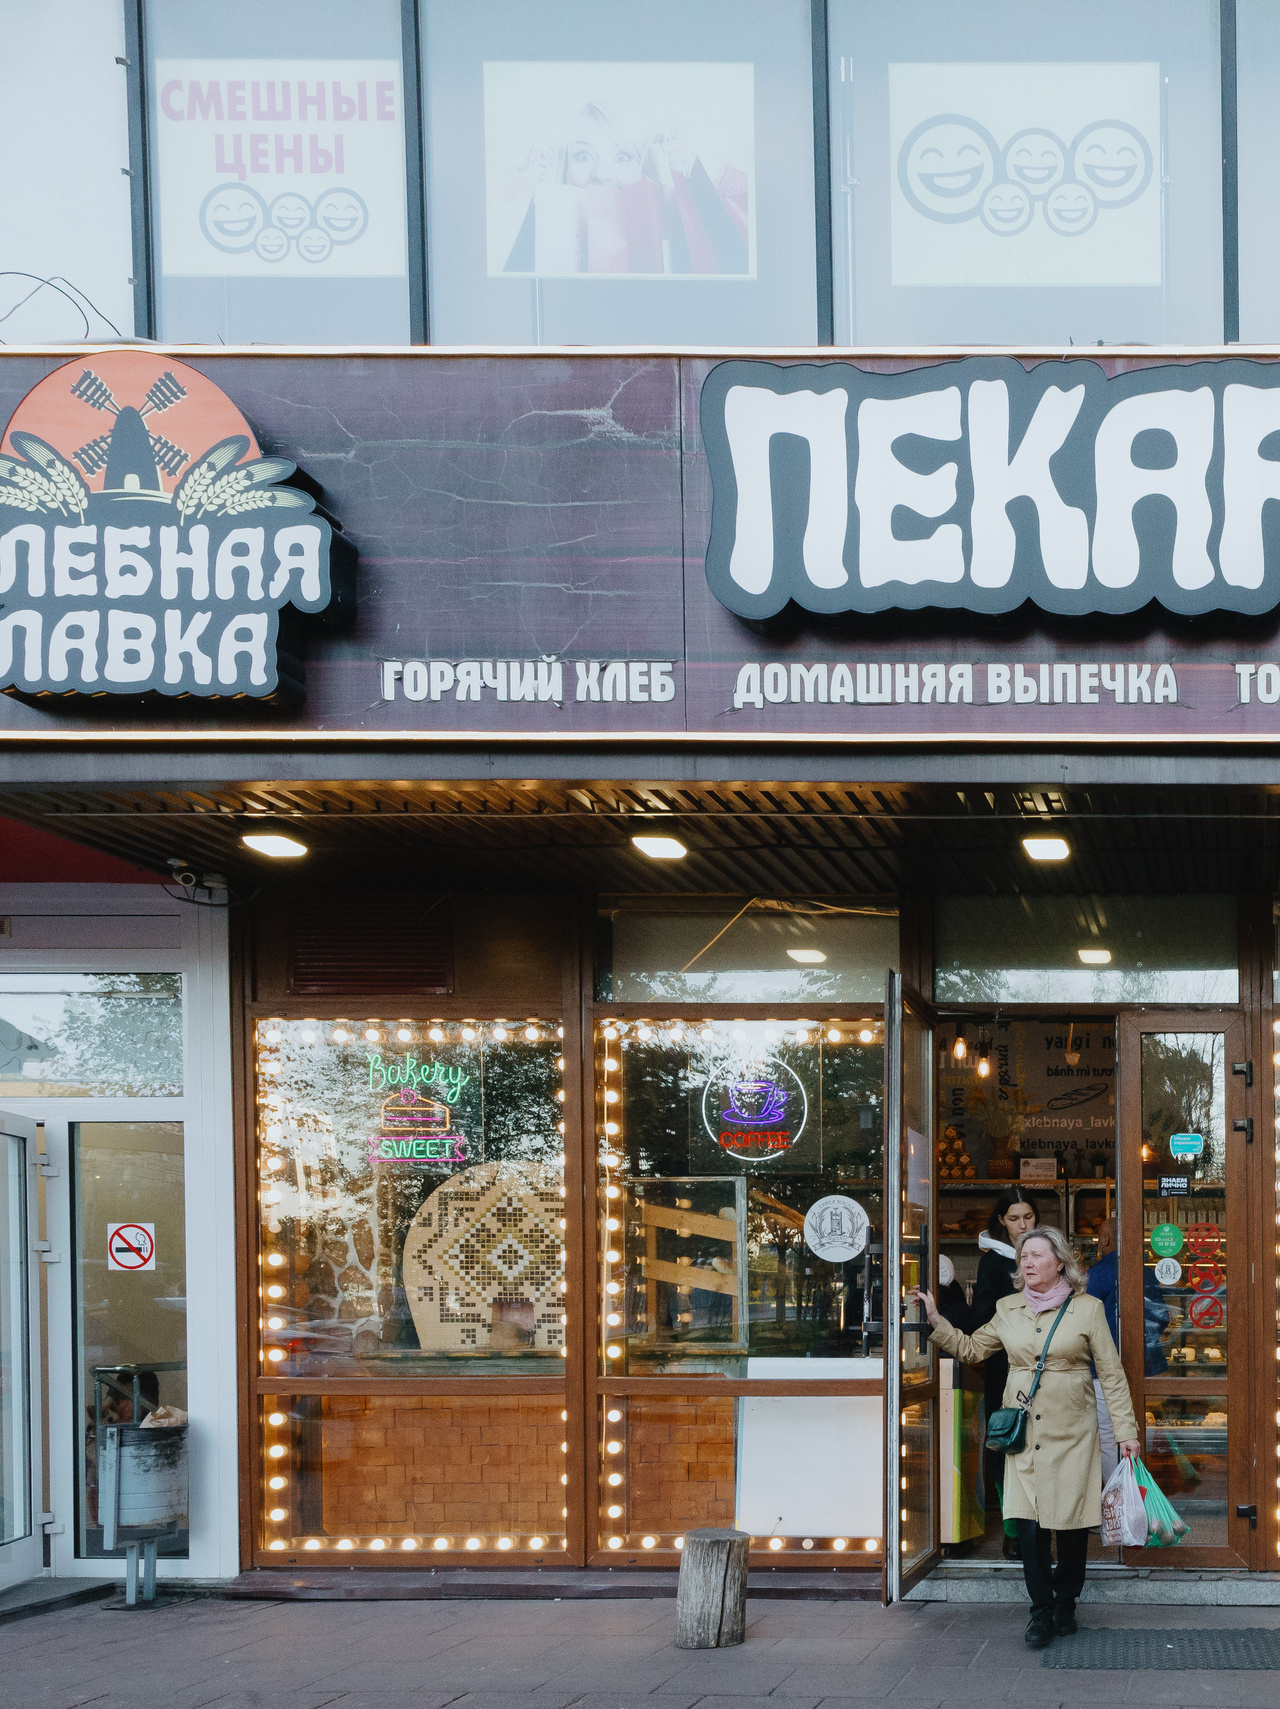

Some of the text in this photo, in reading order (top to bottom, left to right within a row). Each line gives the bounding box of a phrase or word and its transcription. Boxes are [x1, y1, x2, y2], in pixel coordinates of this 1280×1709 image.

[160, 79, 396, 123] СМЕШНЫЕ
[213, 133, 345, 181] ЦЕНЫ
[0, 524, 322, 602] ЛЕБНАЯ
[0, 609, 270, 686] ЛАВКА
[384, 654, 676, 703] ГОРЯЧИЙ ХЛЕБ
[734, 663, 1178, 709] ДОМАШНЯЯ ВЫПЕЧКА
[364, 1052, 470, 1103] Bakery
[719, 1131, 790, 1149] COFFEE
[1024, 1116, 1115, 1130] xlebnaya_lavk
[380, 1139, 454, 1159] SWEET
